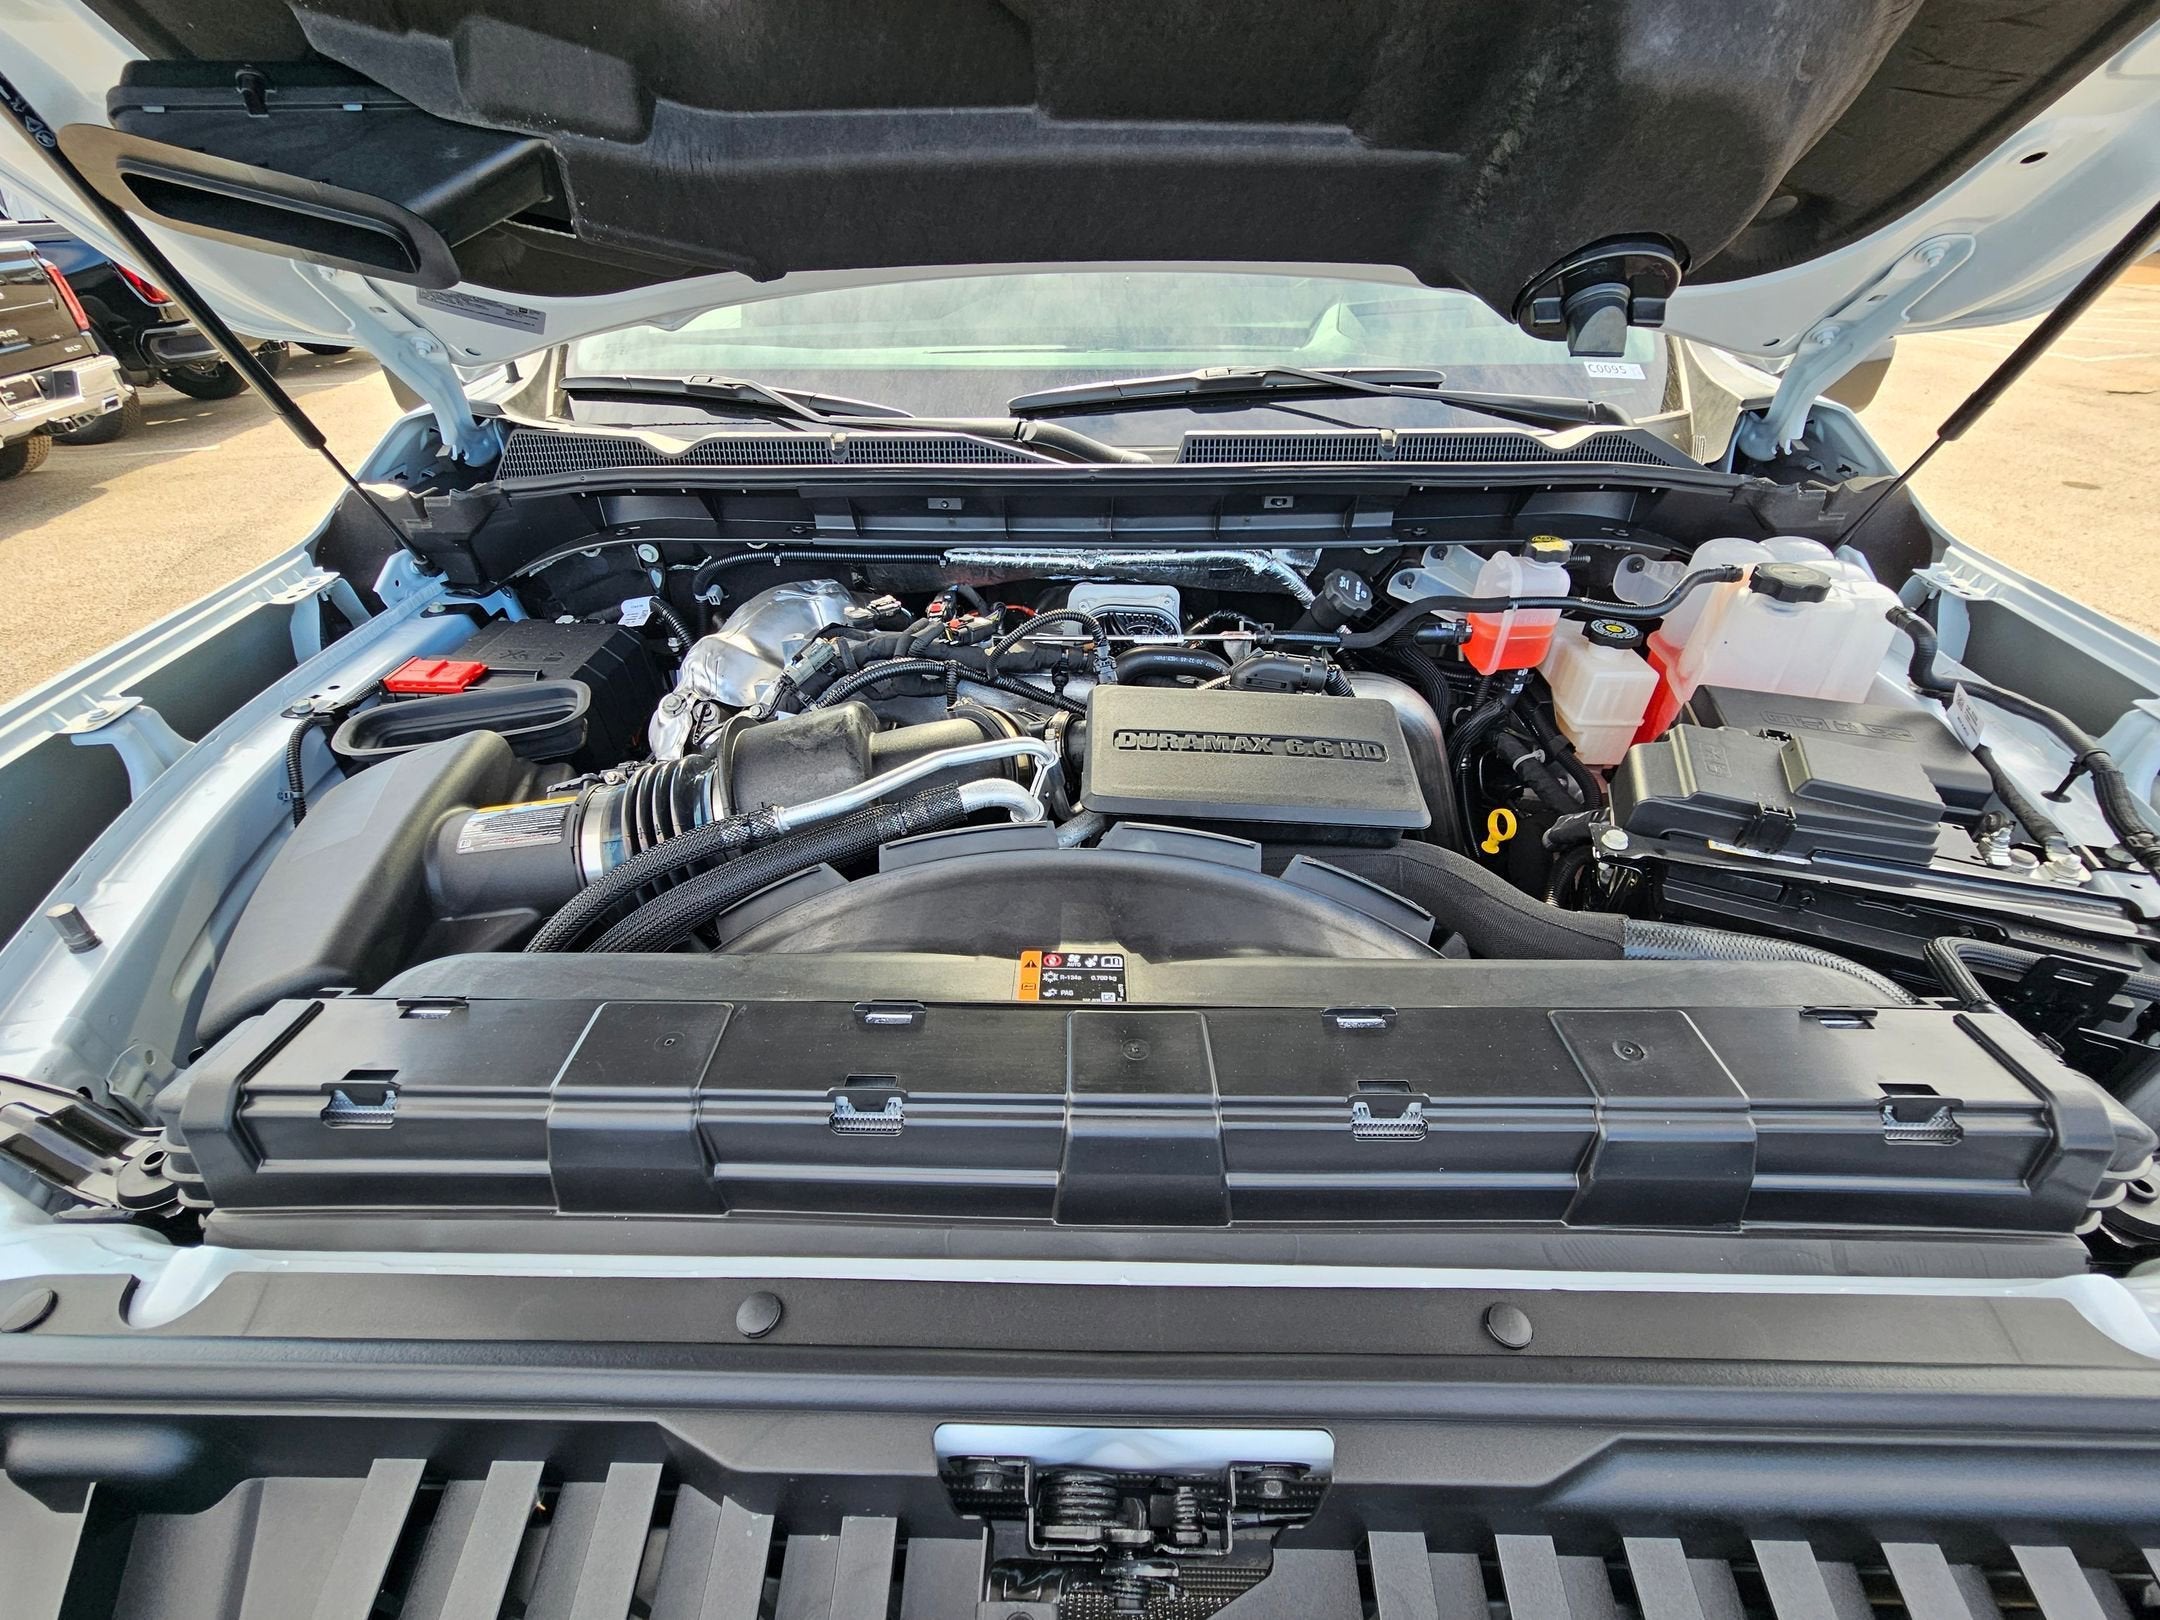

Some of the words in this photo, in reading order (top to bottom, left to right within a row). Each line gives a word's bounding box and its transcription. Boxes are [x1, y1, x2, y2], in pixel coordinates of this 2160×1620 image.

[64, 344, 82, 353] SLT
[1588, 363, 1627, 375] C0095
[1117, 732, 1273, 755] DURAMAX
[1285, 739, 1334, 757] 6.6
[1340, 742, 1384, 760] HD
